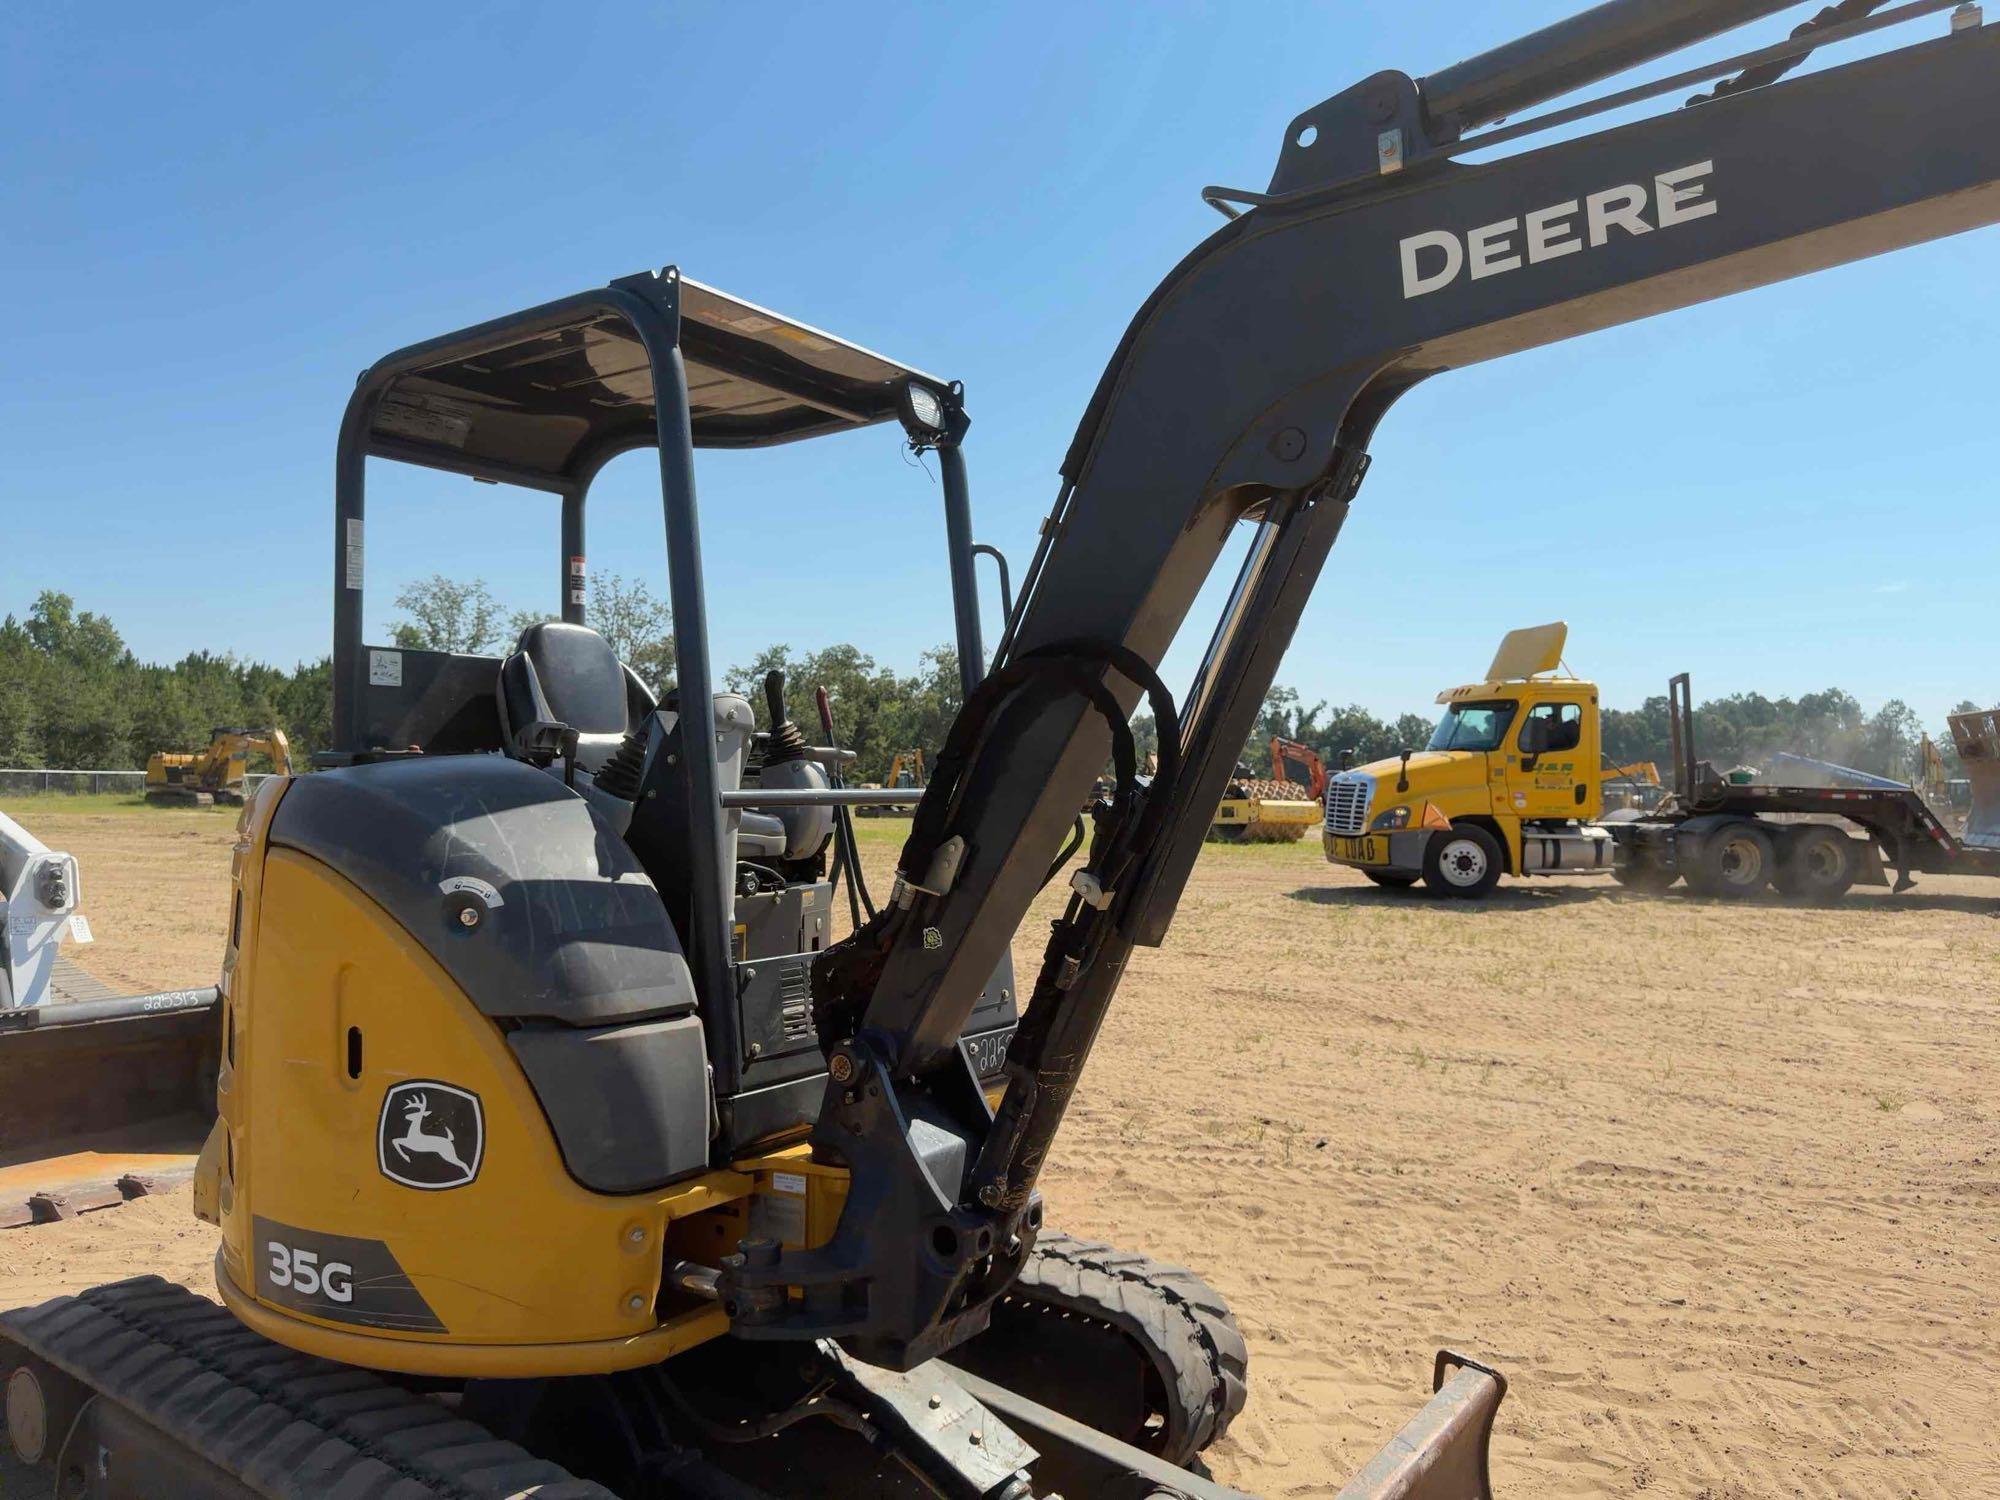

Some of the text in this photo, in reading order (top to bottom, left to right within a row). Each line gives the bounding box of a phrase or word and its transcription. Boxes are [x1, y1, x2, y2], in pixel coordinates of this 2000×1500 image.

[1399, 160, 1718, 300] DEERE
[143, 990, 199, 1011] 225313
[268, 1241, 353, 1303] 35G
